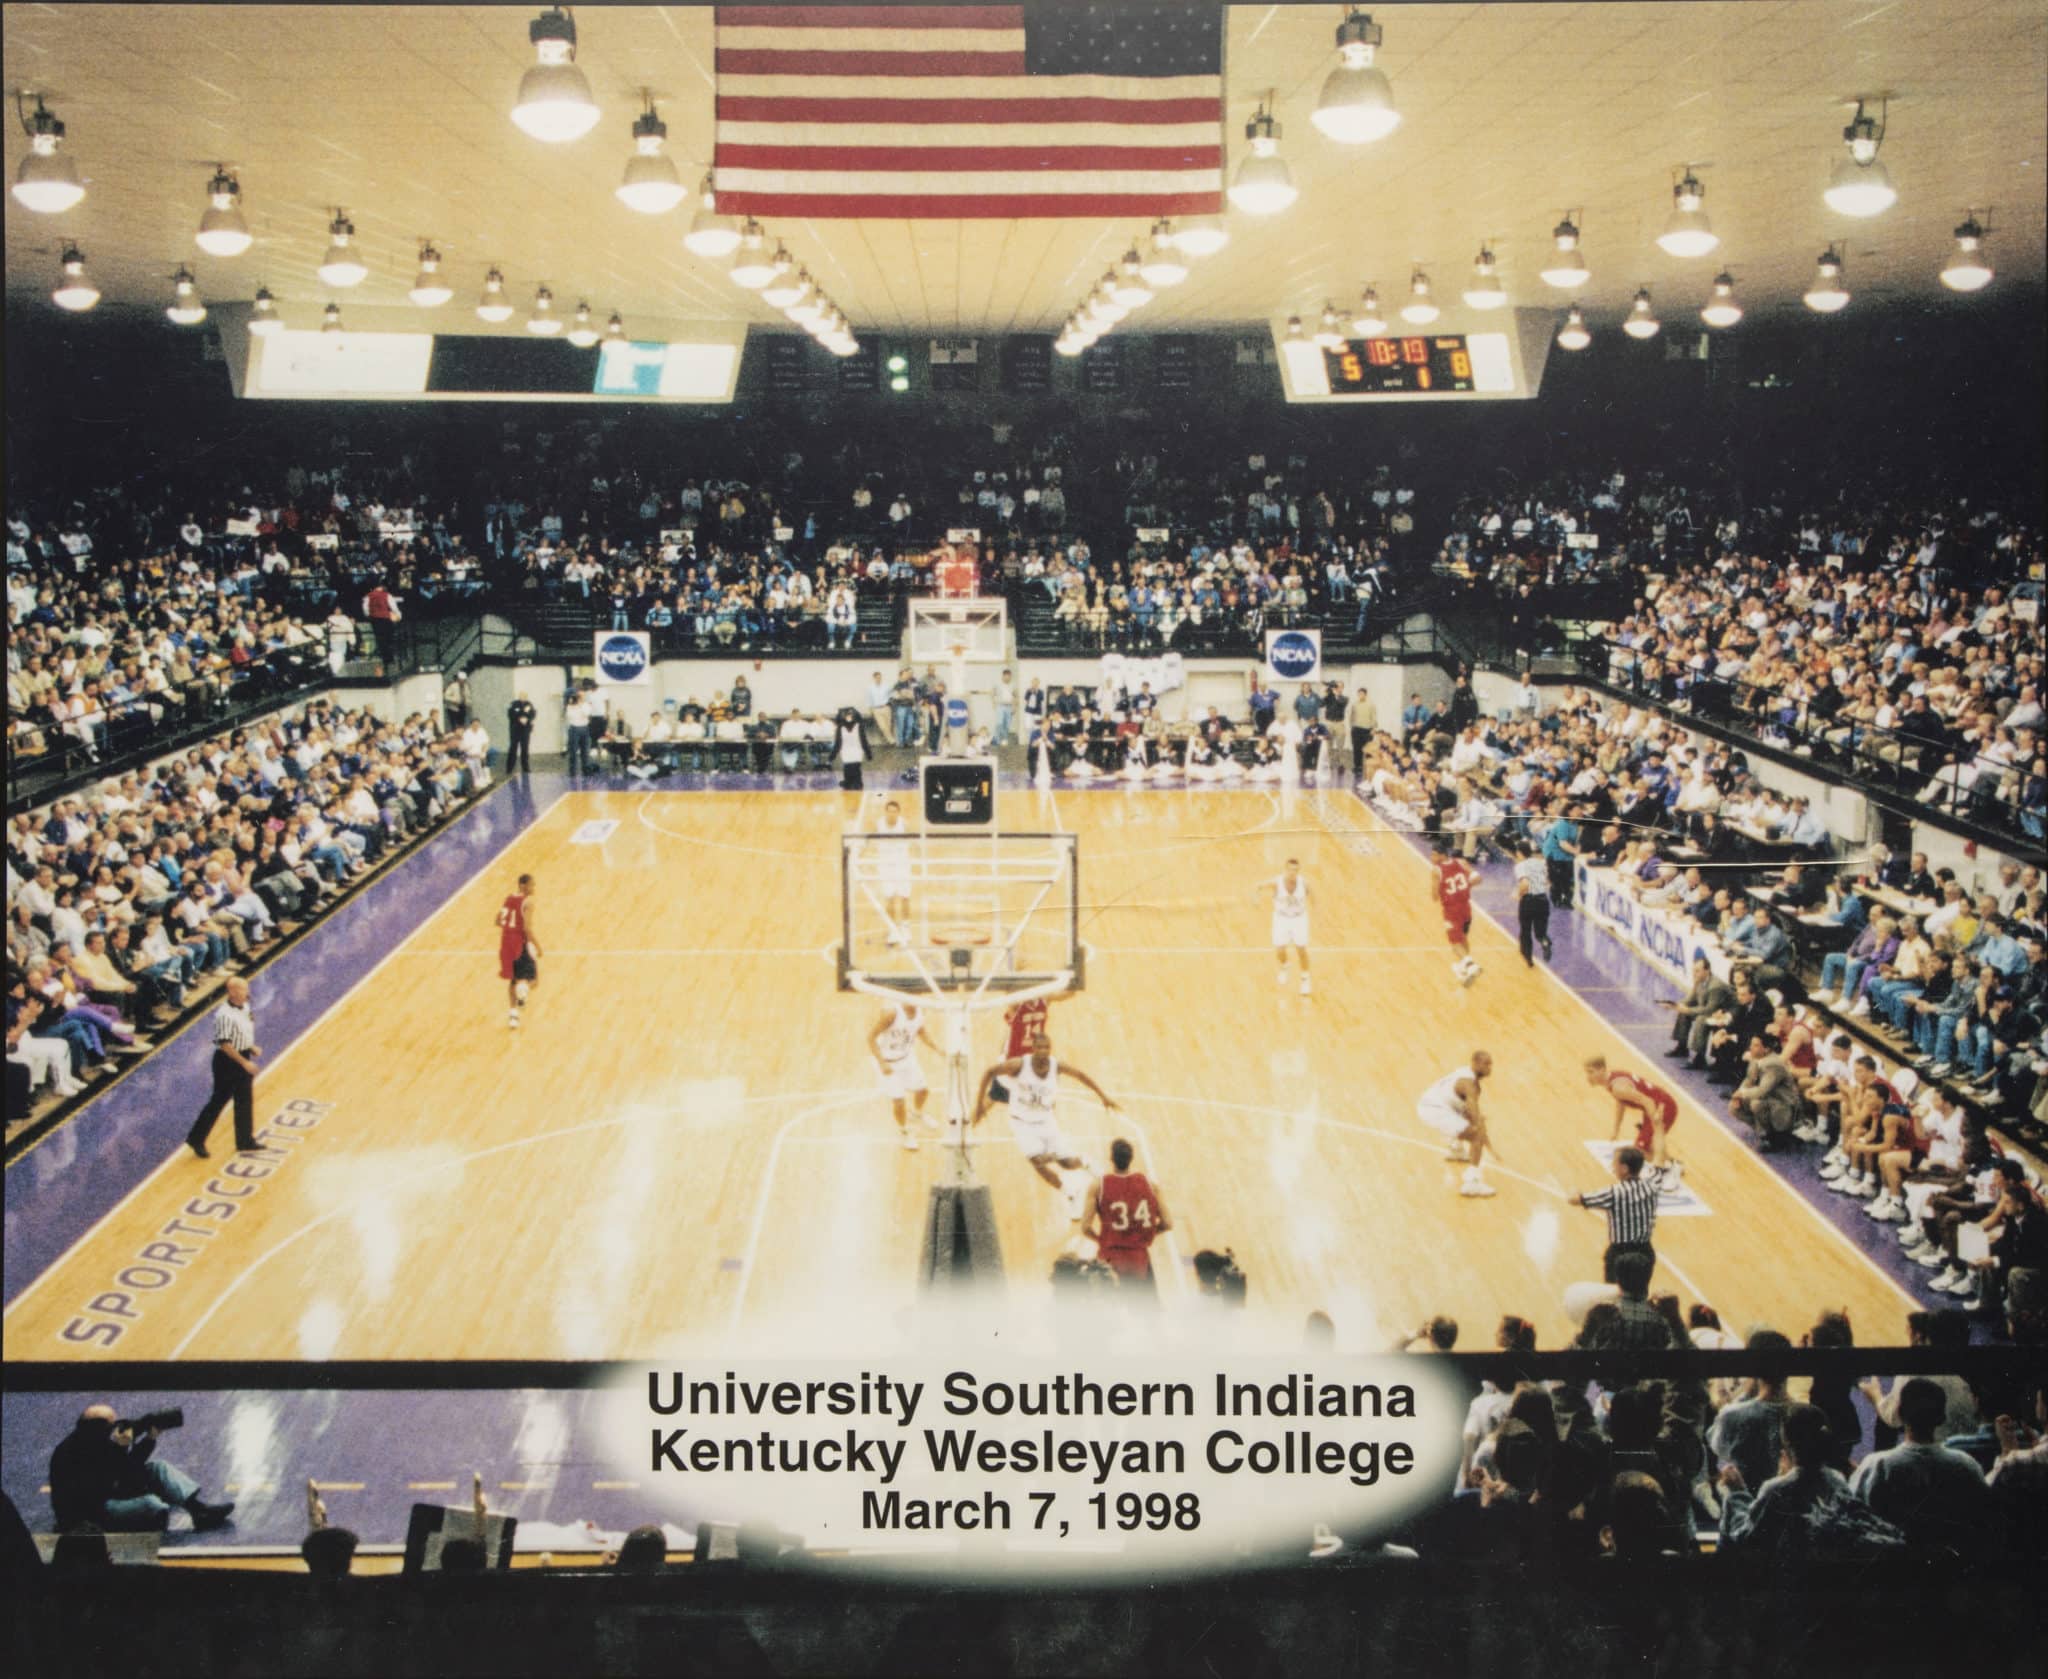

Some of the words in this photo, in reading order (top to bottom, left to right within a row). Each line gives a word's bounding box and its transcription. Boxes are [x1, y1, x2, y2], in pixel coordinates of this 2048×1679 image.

[1341, 352, 1363, 381] 5
[1366, 337, 1428, 366] 10:19
[600, 651, 645, 665] NCAA
[1272, 647, 1315, 663] NCAA
[1595, 880, 1635, 930] NCAA
[1640, 914, 1687, 974] NCAA
[59, 1097, 331, 1348] SPORTSCENTER
[1109, 1198, 1152, 1231] 34
